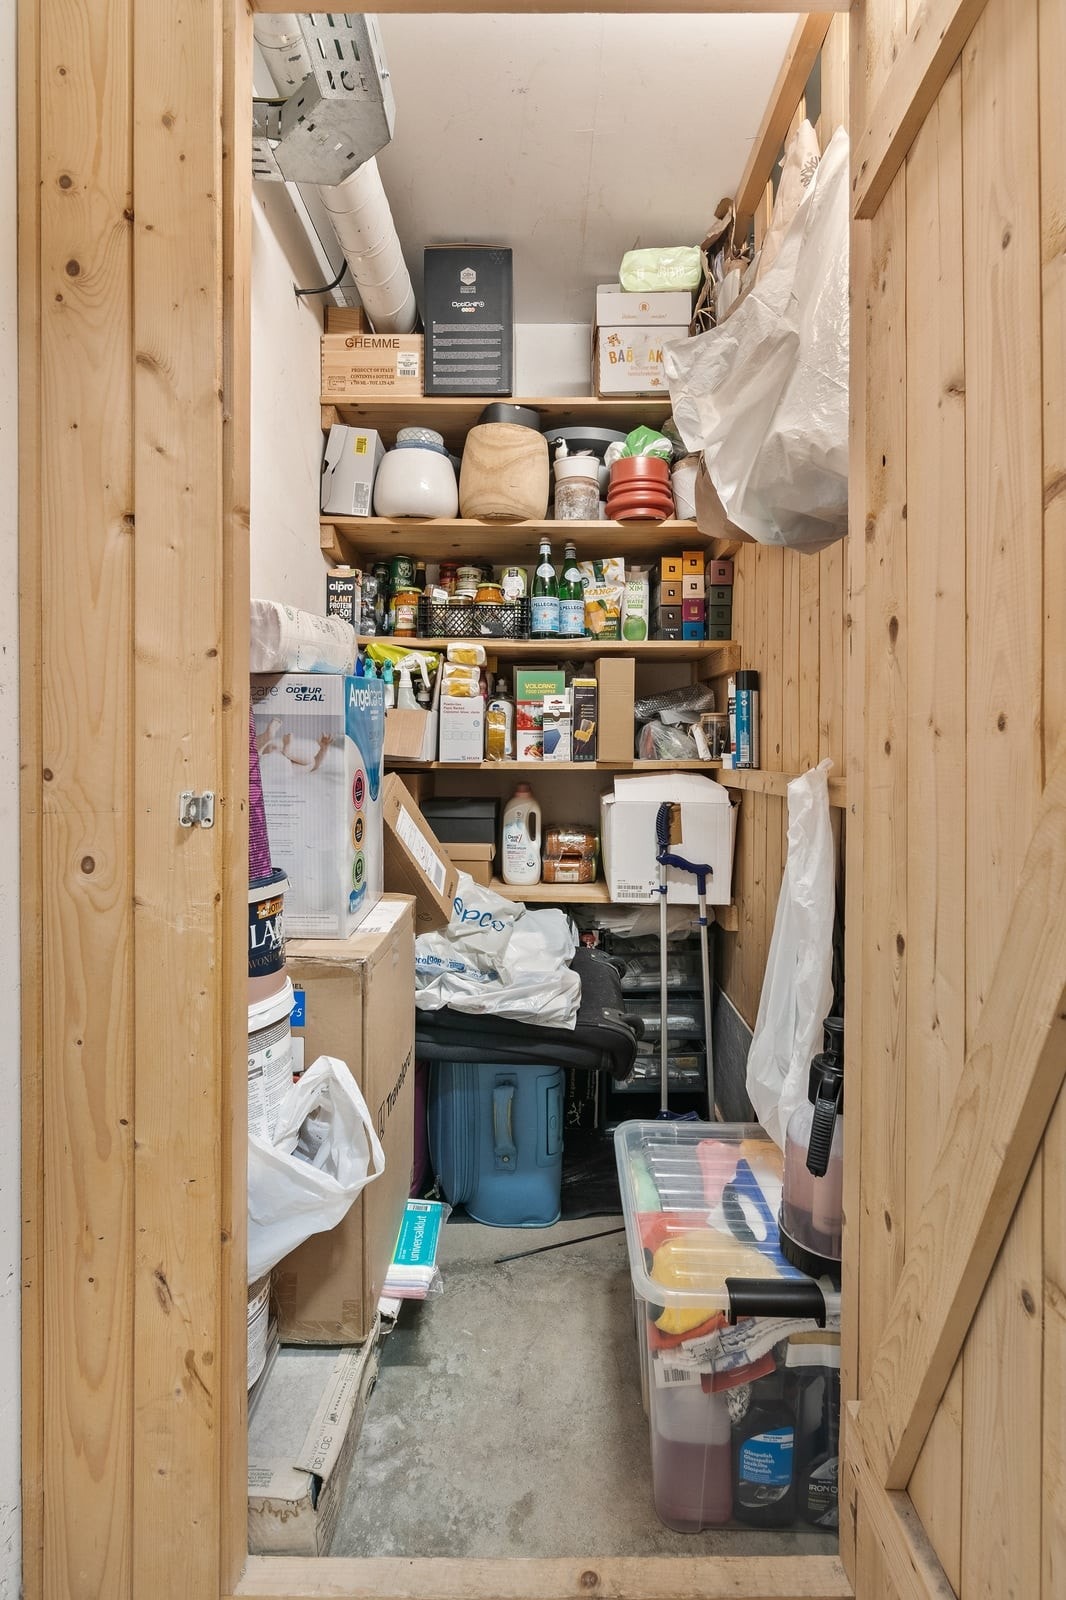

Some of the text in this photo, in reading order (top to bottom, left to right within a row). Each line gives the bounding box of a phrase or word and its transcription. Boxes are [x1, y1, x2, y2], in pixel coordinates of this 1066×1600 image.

[344, 337, 400, 349] GHEMME
[329, 580, 354, 593] alpro
[585, 587, 619, 596] MANGO
[329, 595, 353, 603] PLANT
[294, 693, 325, 702] SEAL
[349, 683, 383, 712] Angelcare
[410, 1215, 427, 1261] universalklut
[808, 1484, 829, 1493] IRON
